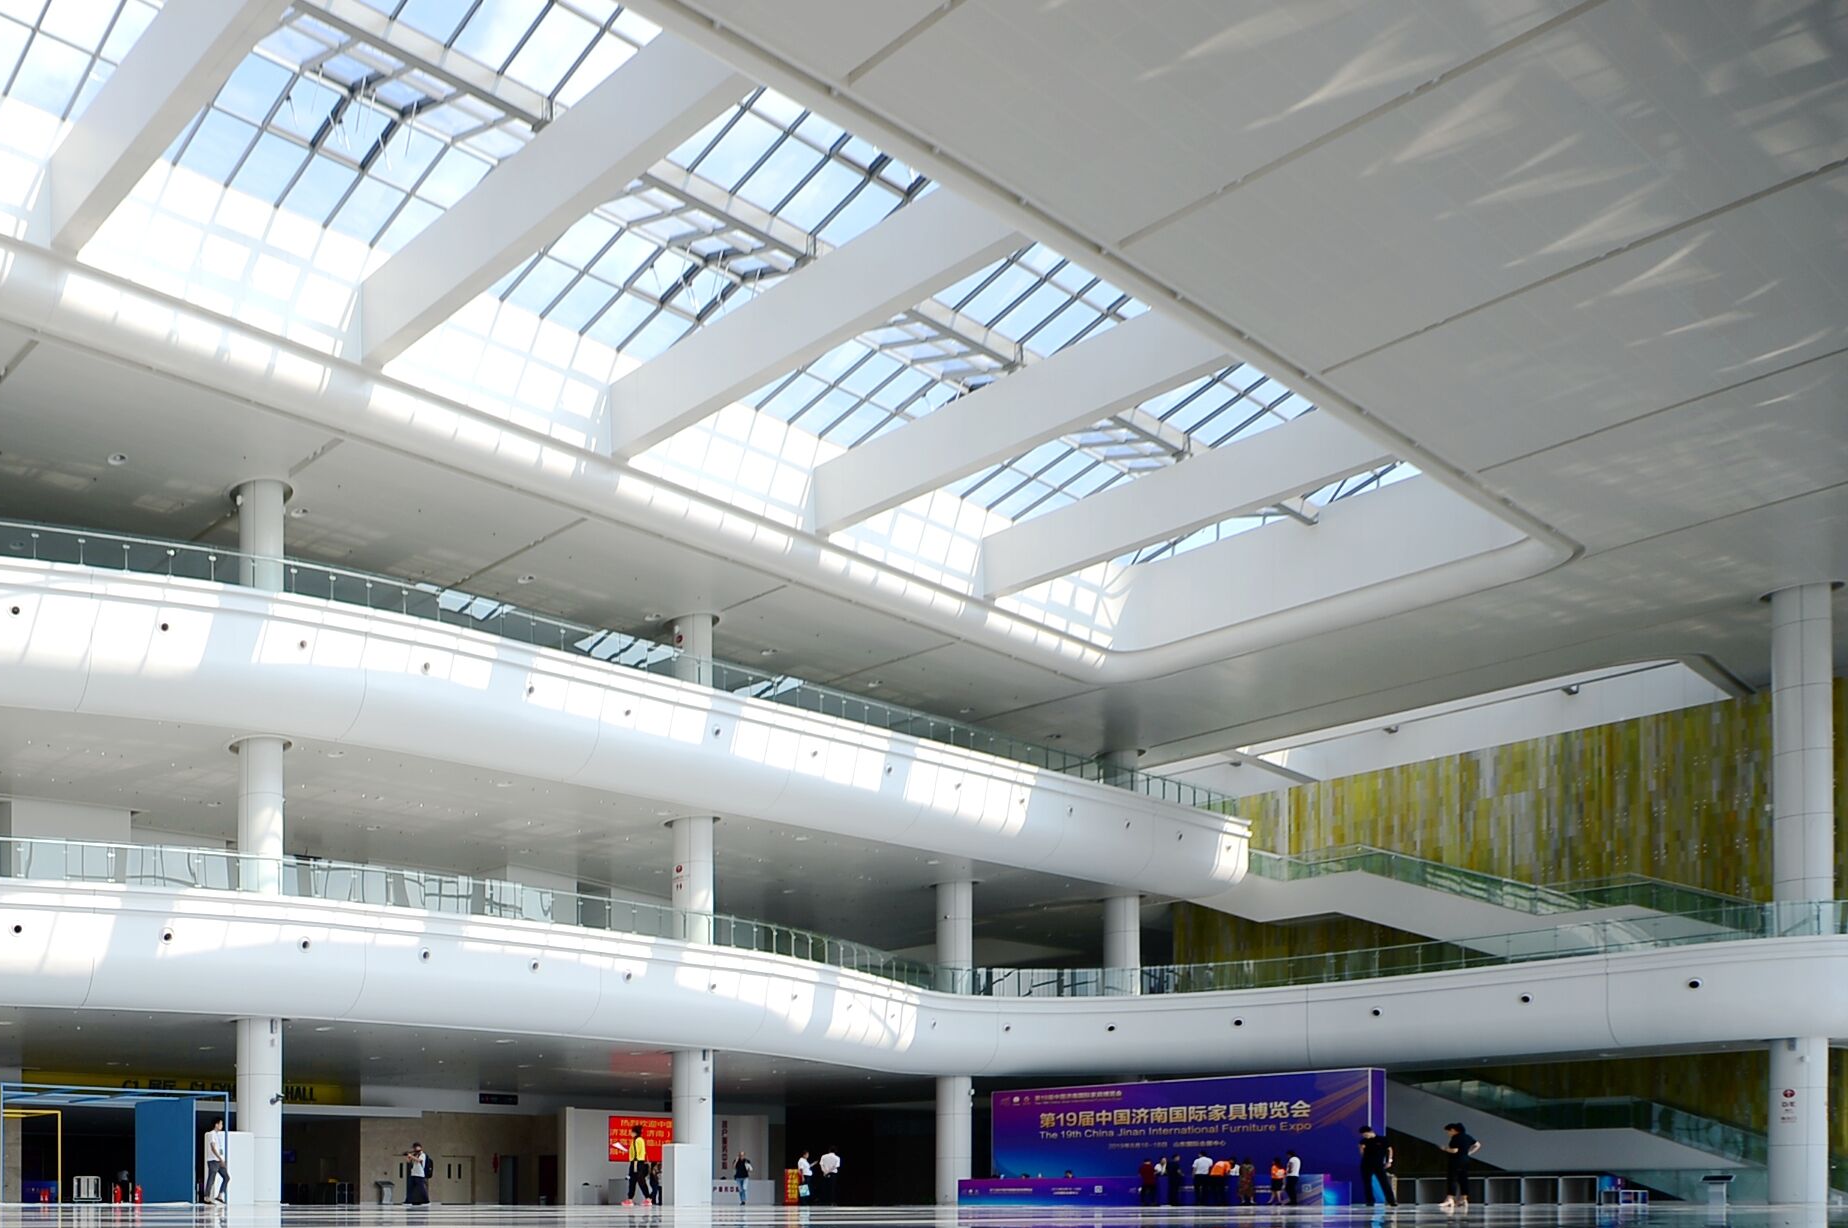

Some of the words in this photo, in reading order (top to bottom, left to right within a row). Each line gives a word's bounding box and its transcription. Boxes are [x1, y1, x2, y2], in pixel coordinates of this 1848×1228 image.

[1040, 1100, 1312, 1128] 第19届中国济南国际家具博览会
[1040, 1131, 1058, 1139] The
[1061, 1130, 1082, 1138] 19th
[1084, 1129, 1114, 1138] China
[1118, 1128, 1145, 1136] Jinan
[1149, 1125, 1218, 1136] International
[1222, 1123, 1276, 1133] Furniture
[1279, 1121, 1312, 1133] Expo
